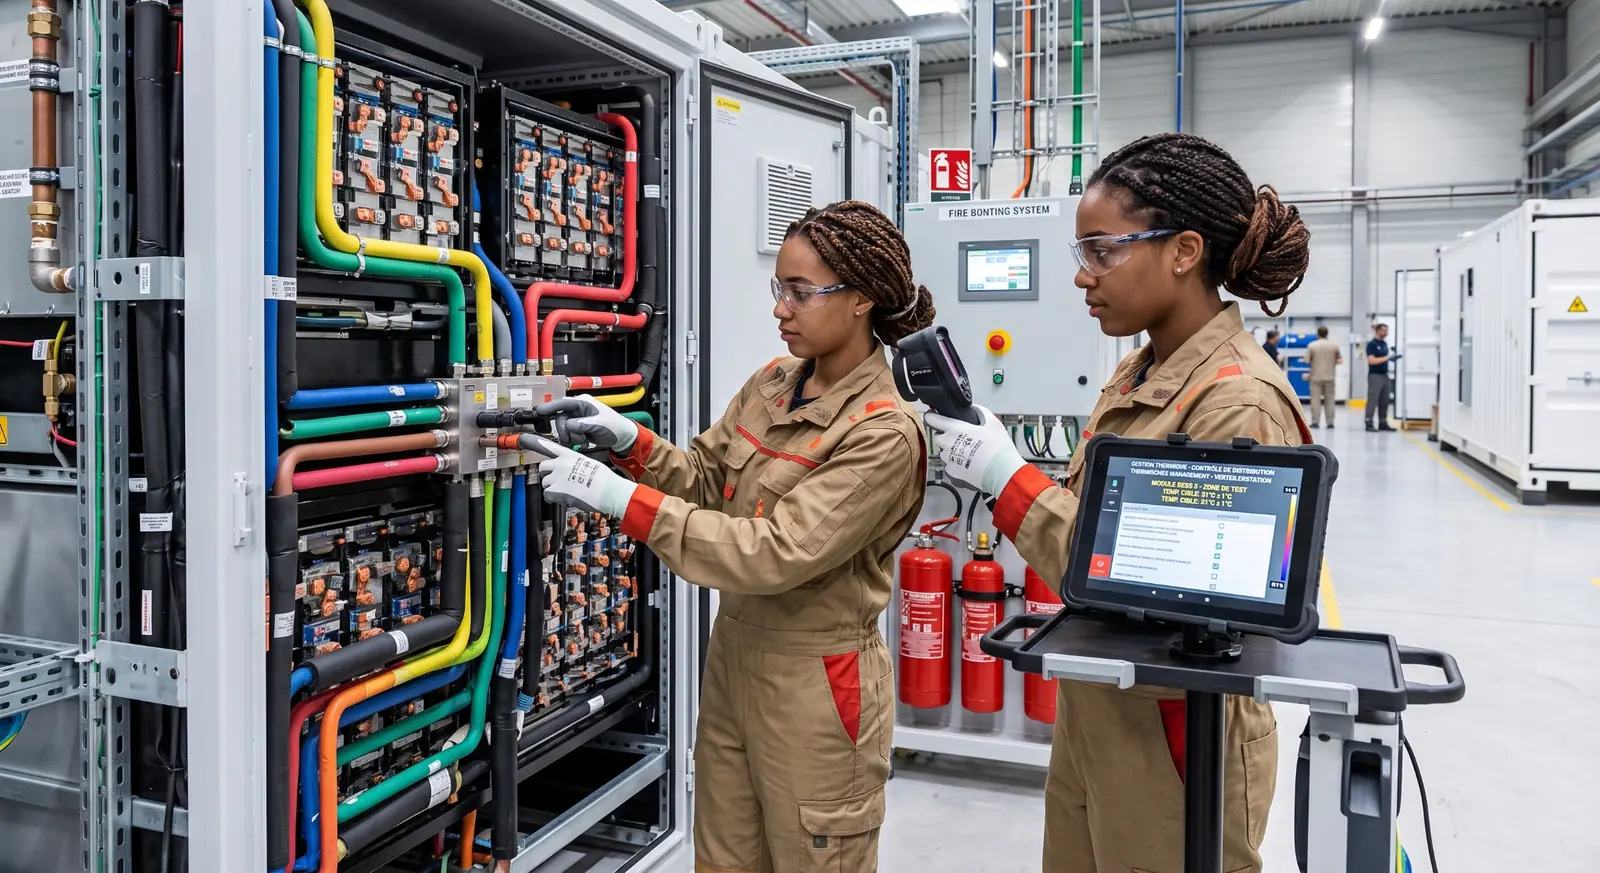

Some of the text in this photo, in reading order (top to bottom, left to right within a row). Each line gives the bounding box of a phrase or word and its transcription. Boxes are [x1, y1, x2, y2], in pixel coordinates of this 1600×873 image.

[948, 205, 1050, 218] FIRE BONTING SYSTEM
[1191, 464, 1222, 473] CONTRÔLE
